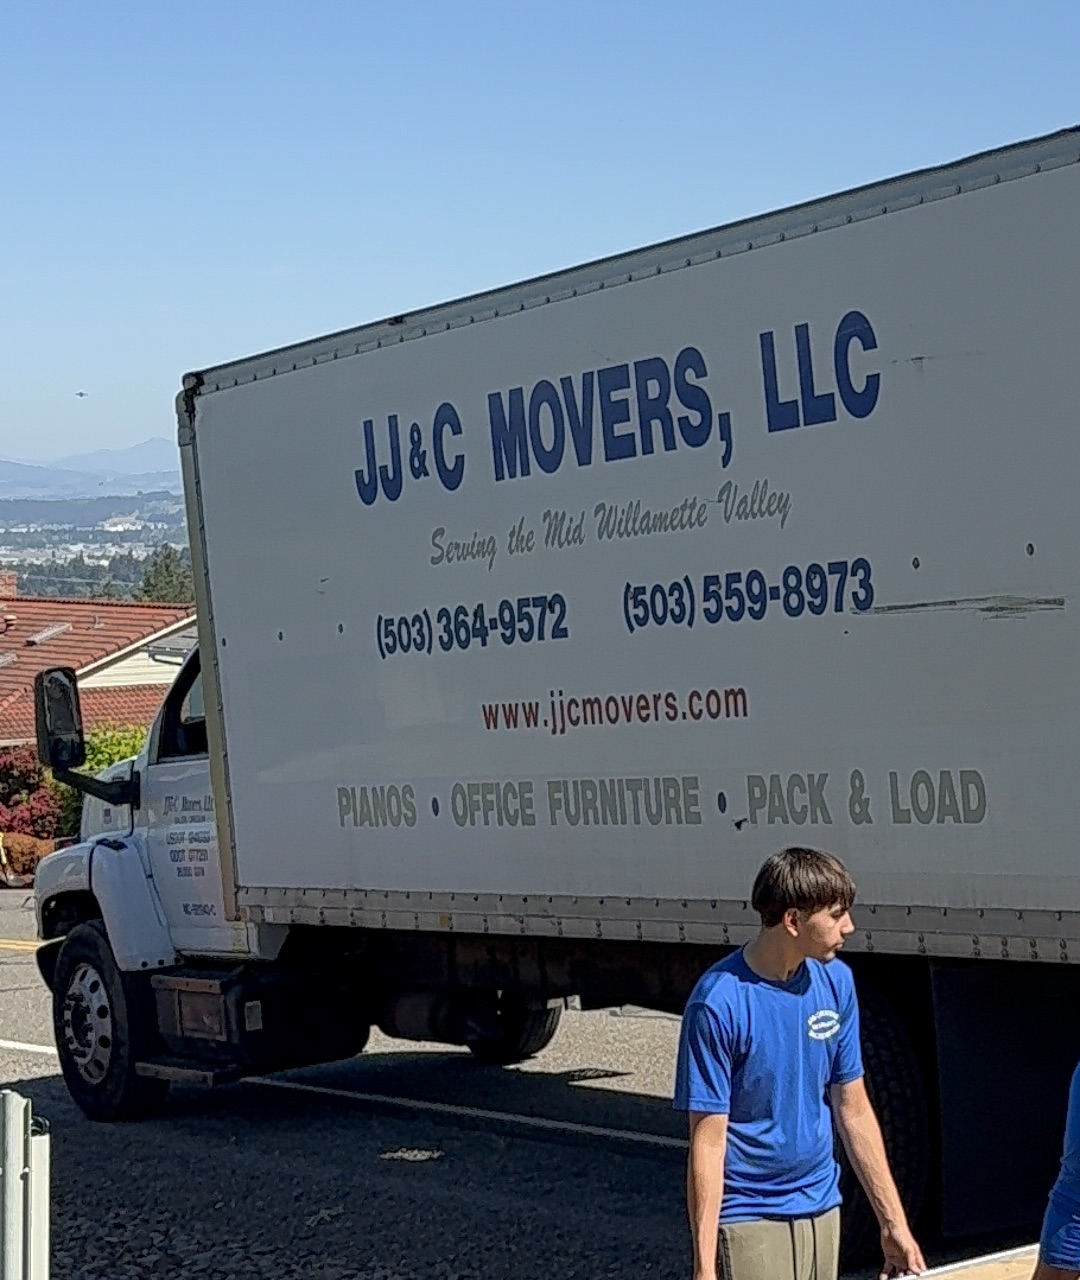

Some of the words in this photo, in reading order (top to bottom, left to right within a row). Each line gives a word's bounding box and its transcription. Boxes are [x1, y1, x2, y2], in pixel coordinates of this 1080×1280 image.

[354, 402, 465, 506] JJ&C
[487, 346, 734, 482] MOVERS,
[759, 310, 881, 434] LLC
[430, 525, 498, 571] Serving
[507, 515, 536, 554] the
[542, 508, 587, 550] Mid
[593, 494, 709, 541] Willamette
[717, 477, 793, 530] Valley
[481, 686, 748, 736] www.jjcmovers.com
[336, 784, 417, 828] PIANOS
[450, 780, 537, 828] OFFICE
[546, 776, 702, 827] FURNITURE
[746, 772, 834, 826] PACK
[848, 768, 874, 826] &
[888, 769, 987, 825] LOAD
